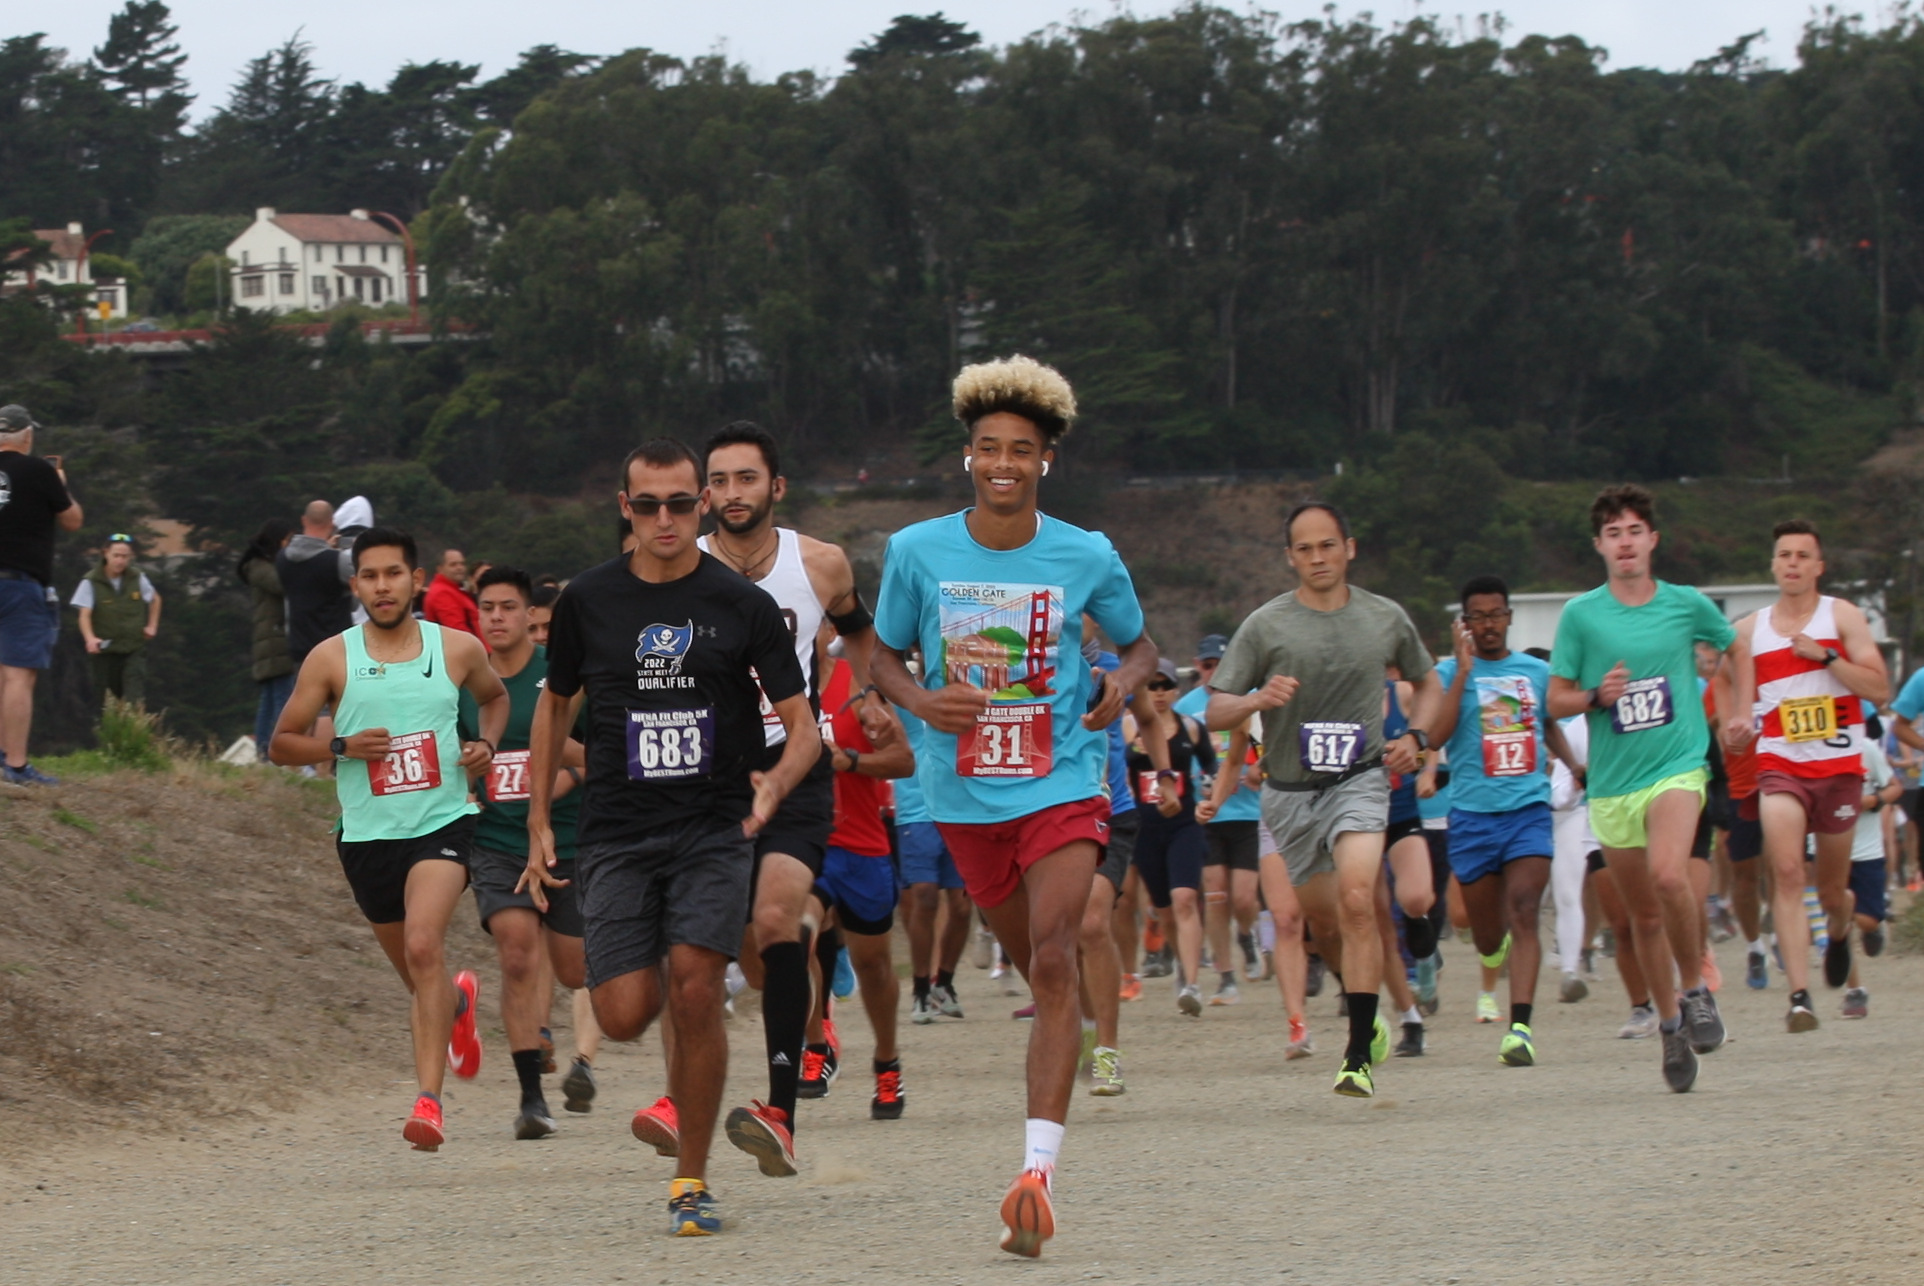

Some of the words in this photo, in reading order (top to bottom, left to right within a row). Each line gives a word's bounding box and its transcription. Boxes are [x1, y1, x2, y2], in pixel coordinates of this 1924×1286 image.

[941, 588, 979, 597] GOLDEN
[982, 589, 1006, 598] GATE
[644, 658, 665, 668] 2022
[637, 676, 695, 690] QUALIFIER
[1616, 689, 1666, 725] 682
[1788, 707, 1827, 734] 310
[638, 726, 702, 769] 683
[981, 724, 1024, 765] 31
[1308, 734, 1357, 765] 617
[1497, 742, 1525, 769] 12
[385, 749, 422, 785] 36
[495, 764, 524, 793] 27
